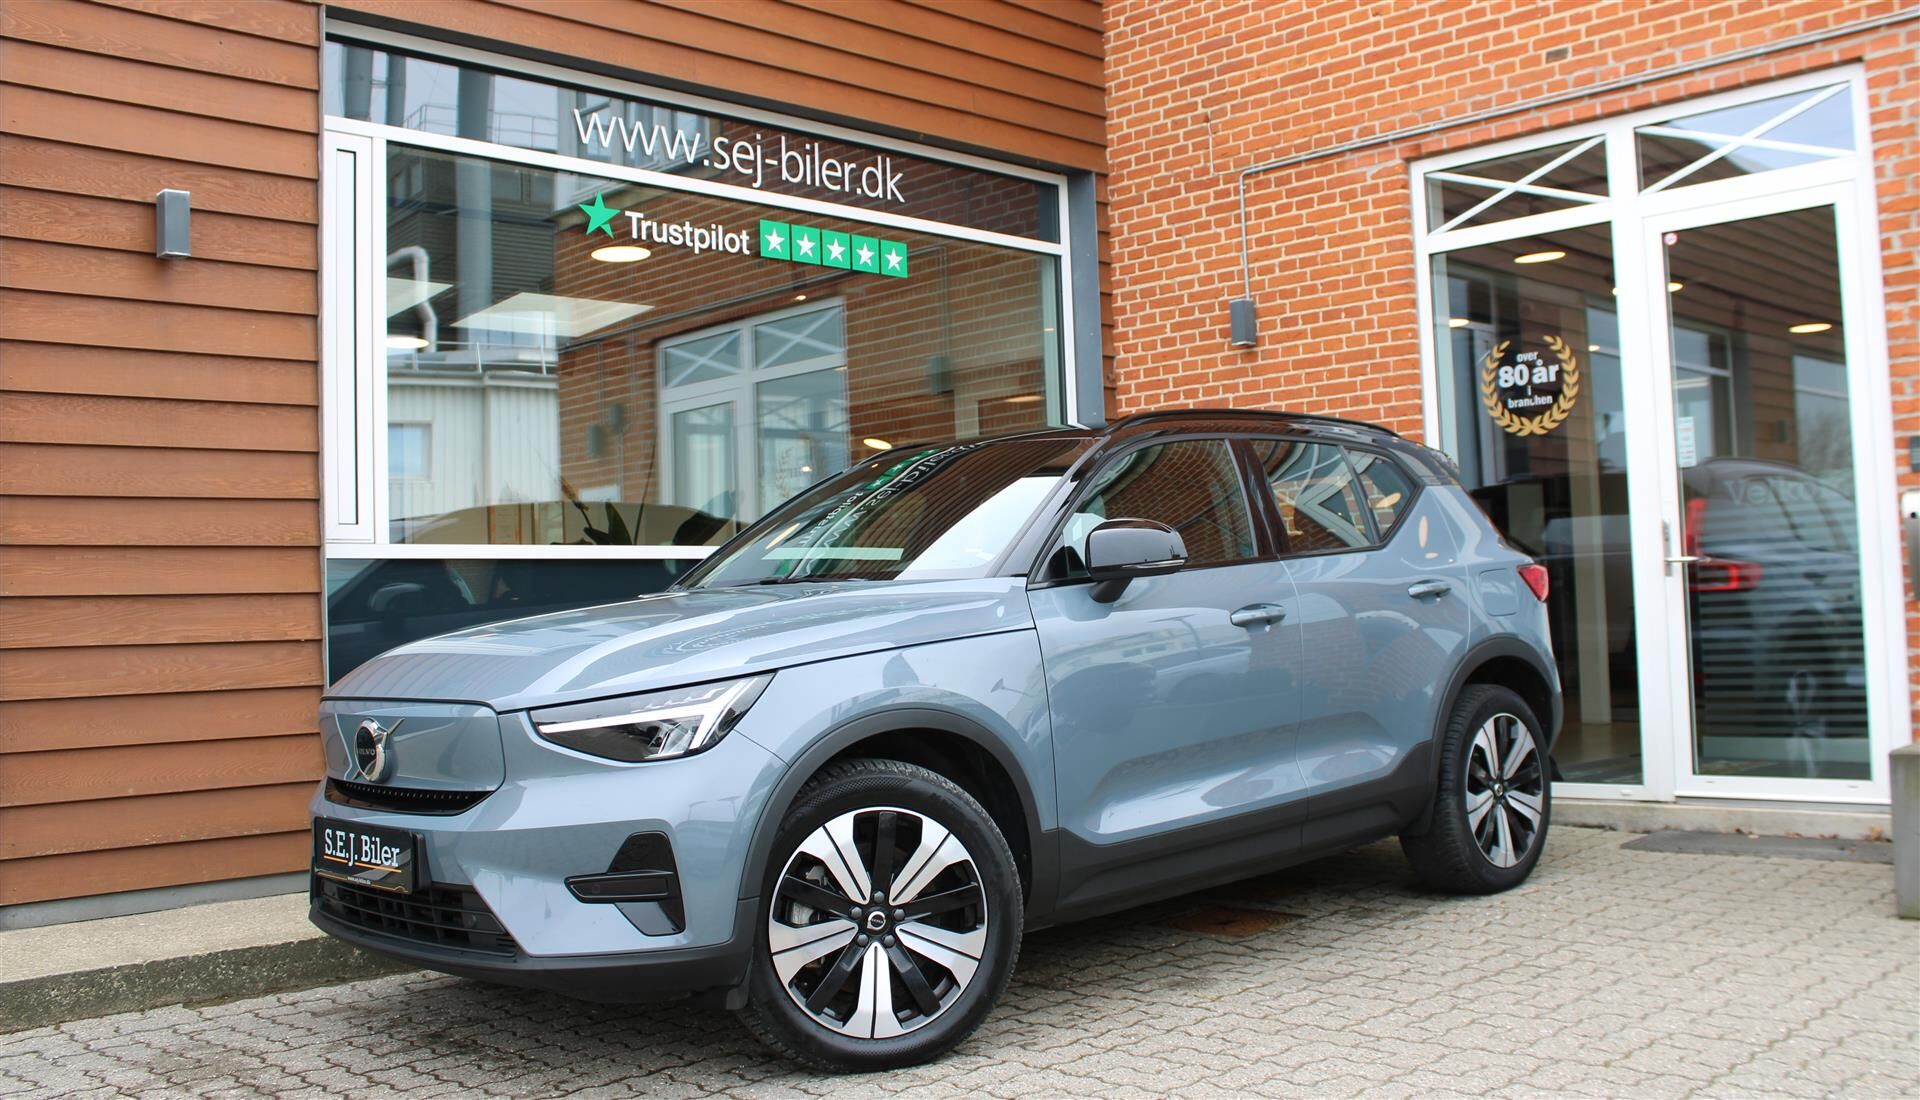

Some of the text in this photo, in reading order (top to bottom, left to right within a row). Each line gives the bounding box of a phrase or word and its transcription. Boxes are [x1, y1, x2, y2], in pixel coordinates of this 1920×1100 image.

[573, 108, 905, 202] www.sej-biler.dk
[625, 210, 751, 255] Trustpilot
[1498, 359, 1560, 388] 80 år
[1516, 351, 1539, 362] over
[324, 828, 400, 868] S.E.J. Biler
